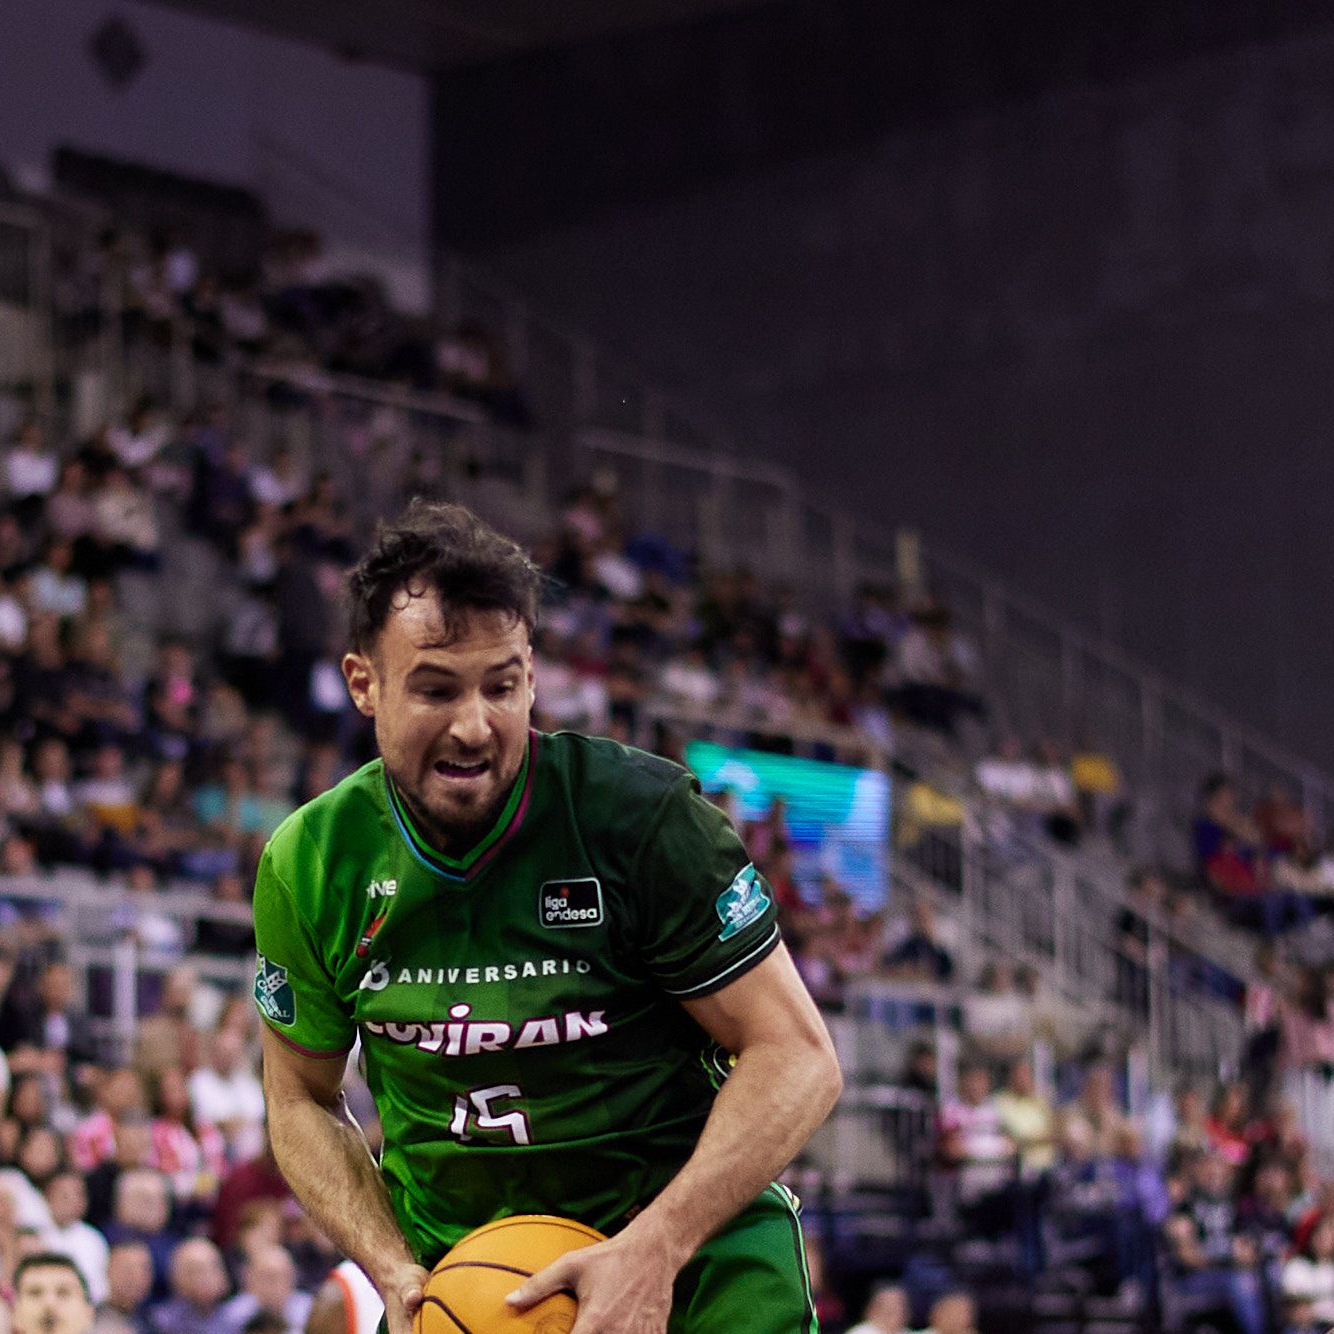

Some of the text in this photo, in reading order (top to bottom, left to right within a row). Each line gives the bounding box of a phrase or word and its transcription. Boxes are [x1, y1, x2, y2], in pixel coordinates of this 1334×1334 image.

[545, 895, 568, 911] liga
[545, 907, 598, 922] endesa
[397, 959, 591, 985] ANIVERSARIO
